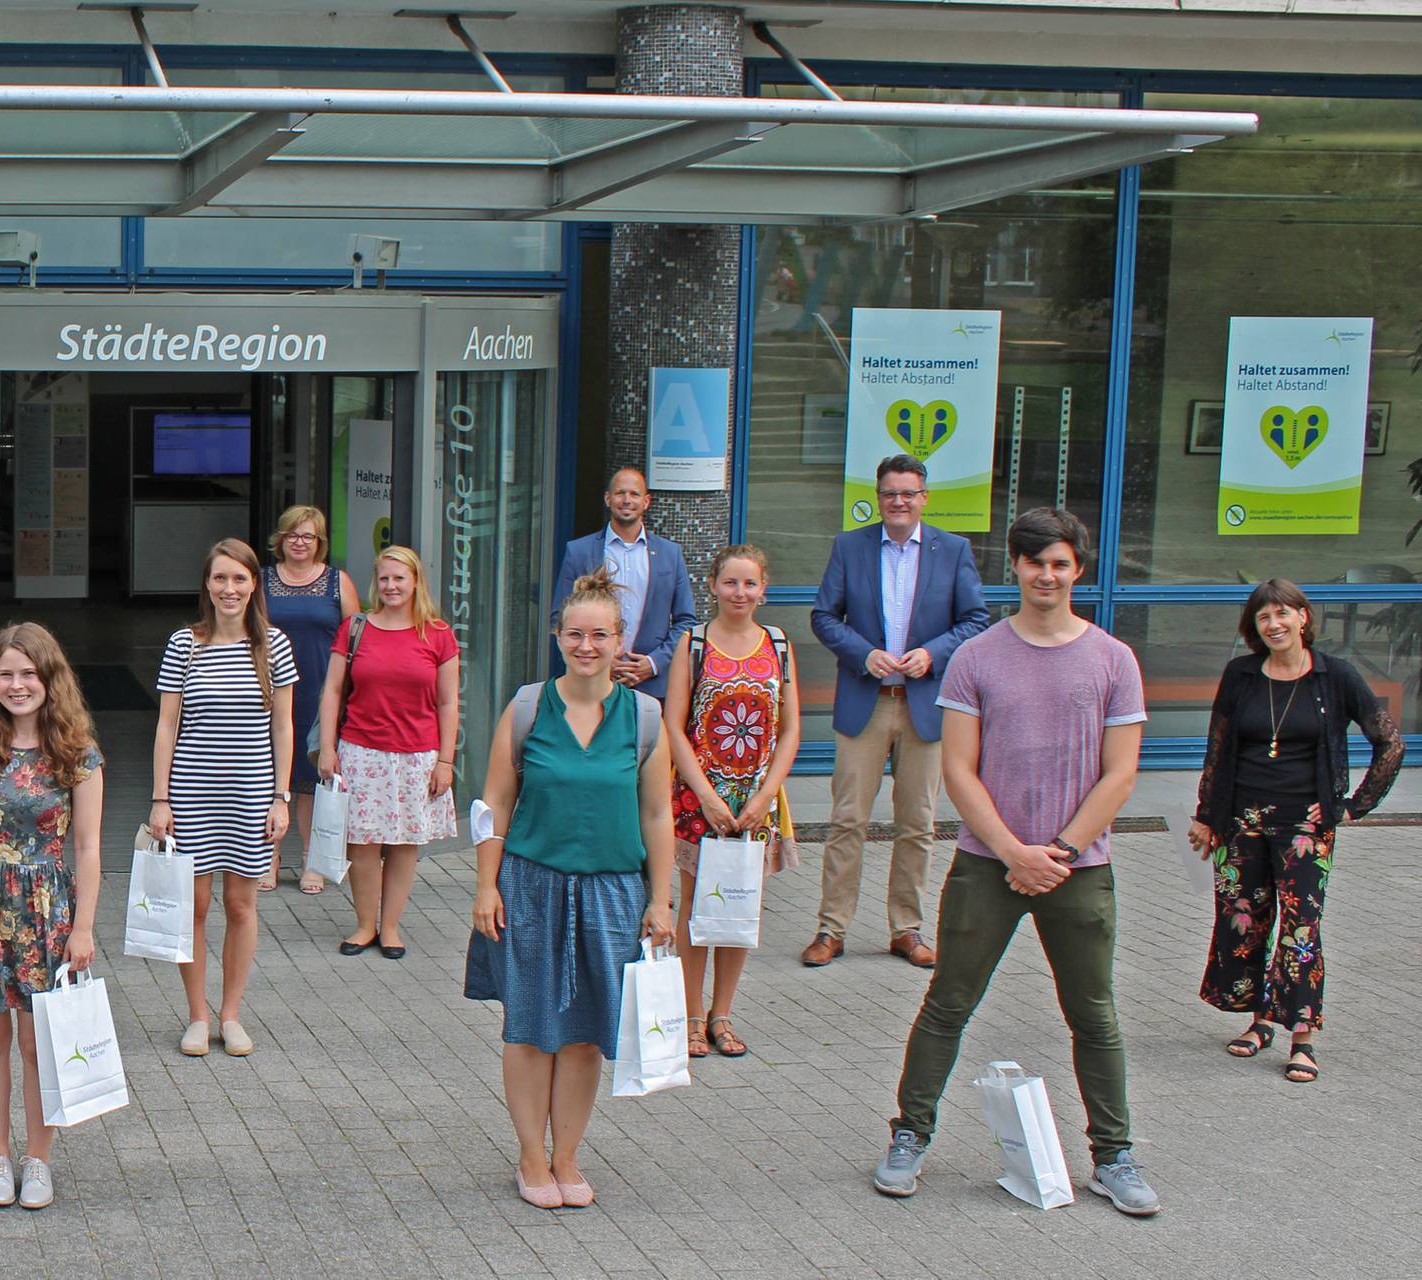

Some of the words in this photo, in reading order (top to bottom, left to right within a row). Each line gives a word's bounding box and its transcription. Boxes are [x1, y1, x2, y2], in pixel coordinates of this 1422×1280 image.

[56, 323, 327, 371] StädteRegion
[463, 324, 533, 360] Aachen
[862, 356, 902, 368] Haltet
[904, 358, 978, 370] zusammen!
[1238, 364, 1276, 376] Haltet
[1279, 364, 1350, 376] zusammen!
[861, 372, 898, 384] Haltet
[901, 373, 955, 385] Abstand!
[1238, 380, 1272, 391] Haltet
[1276, 380, 1328, 391] Abstand!
[653, 383, 711, 452] A
[450, 404, 474, 454] 10
[355, 469, 383, 484] Haltet
[355, 486, 381, 500] Haltet
